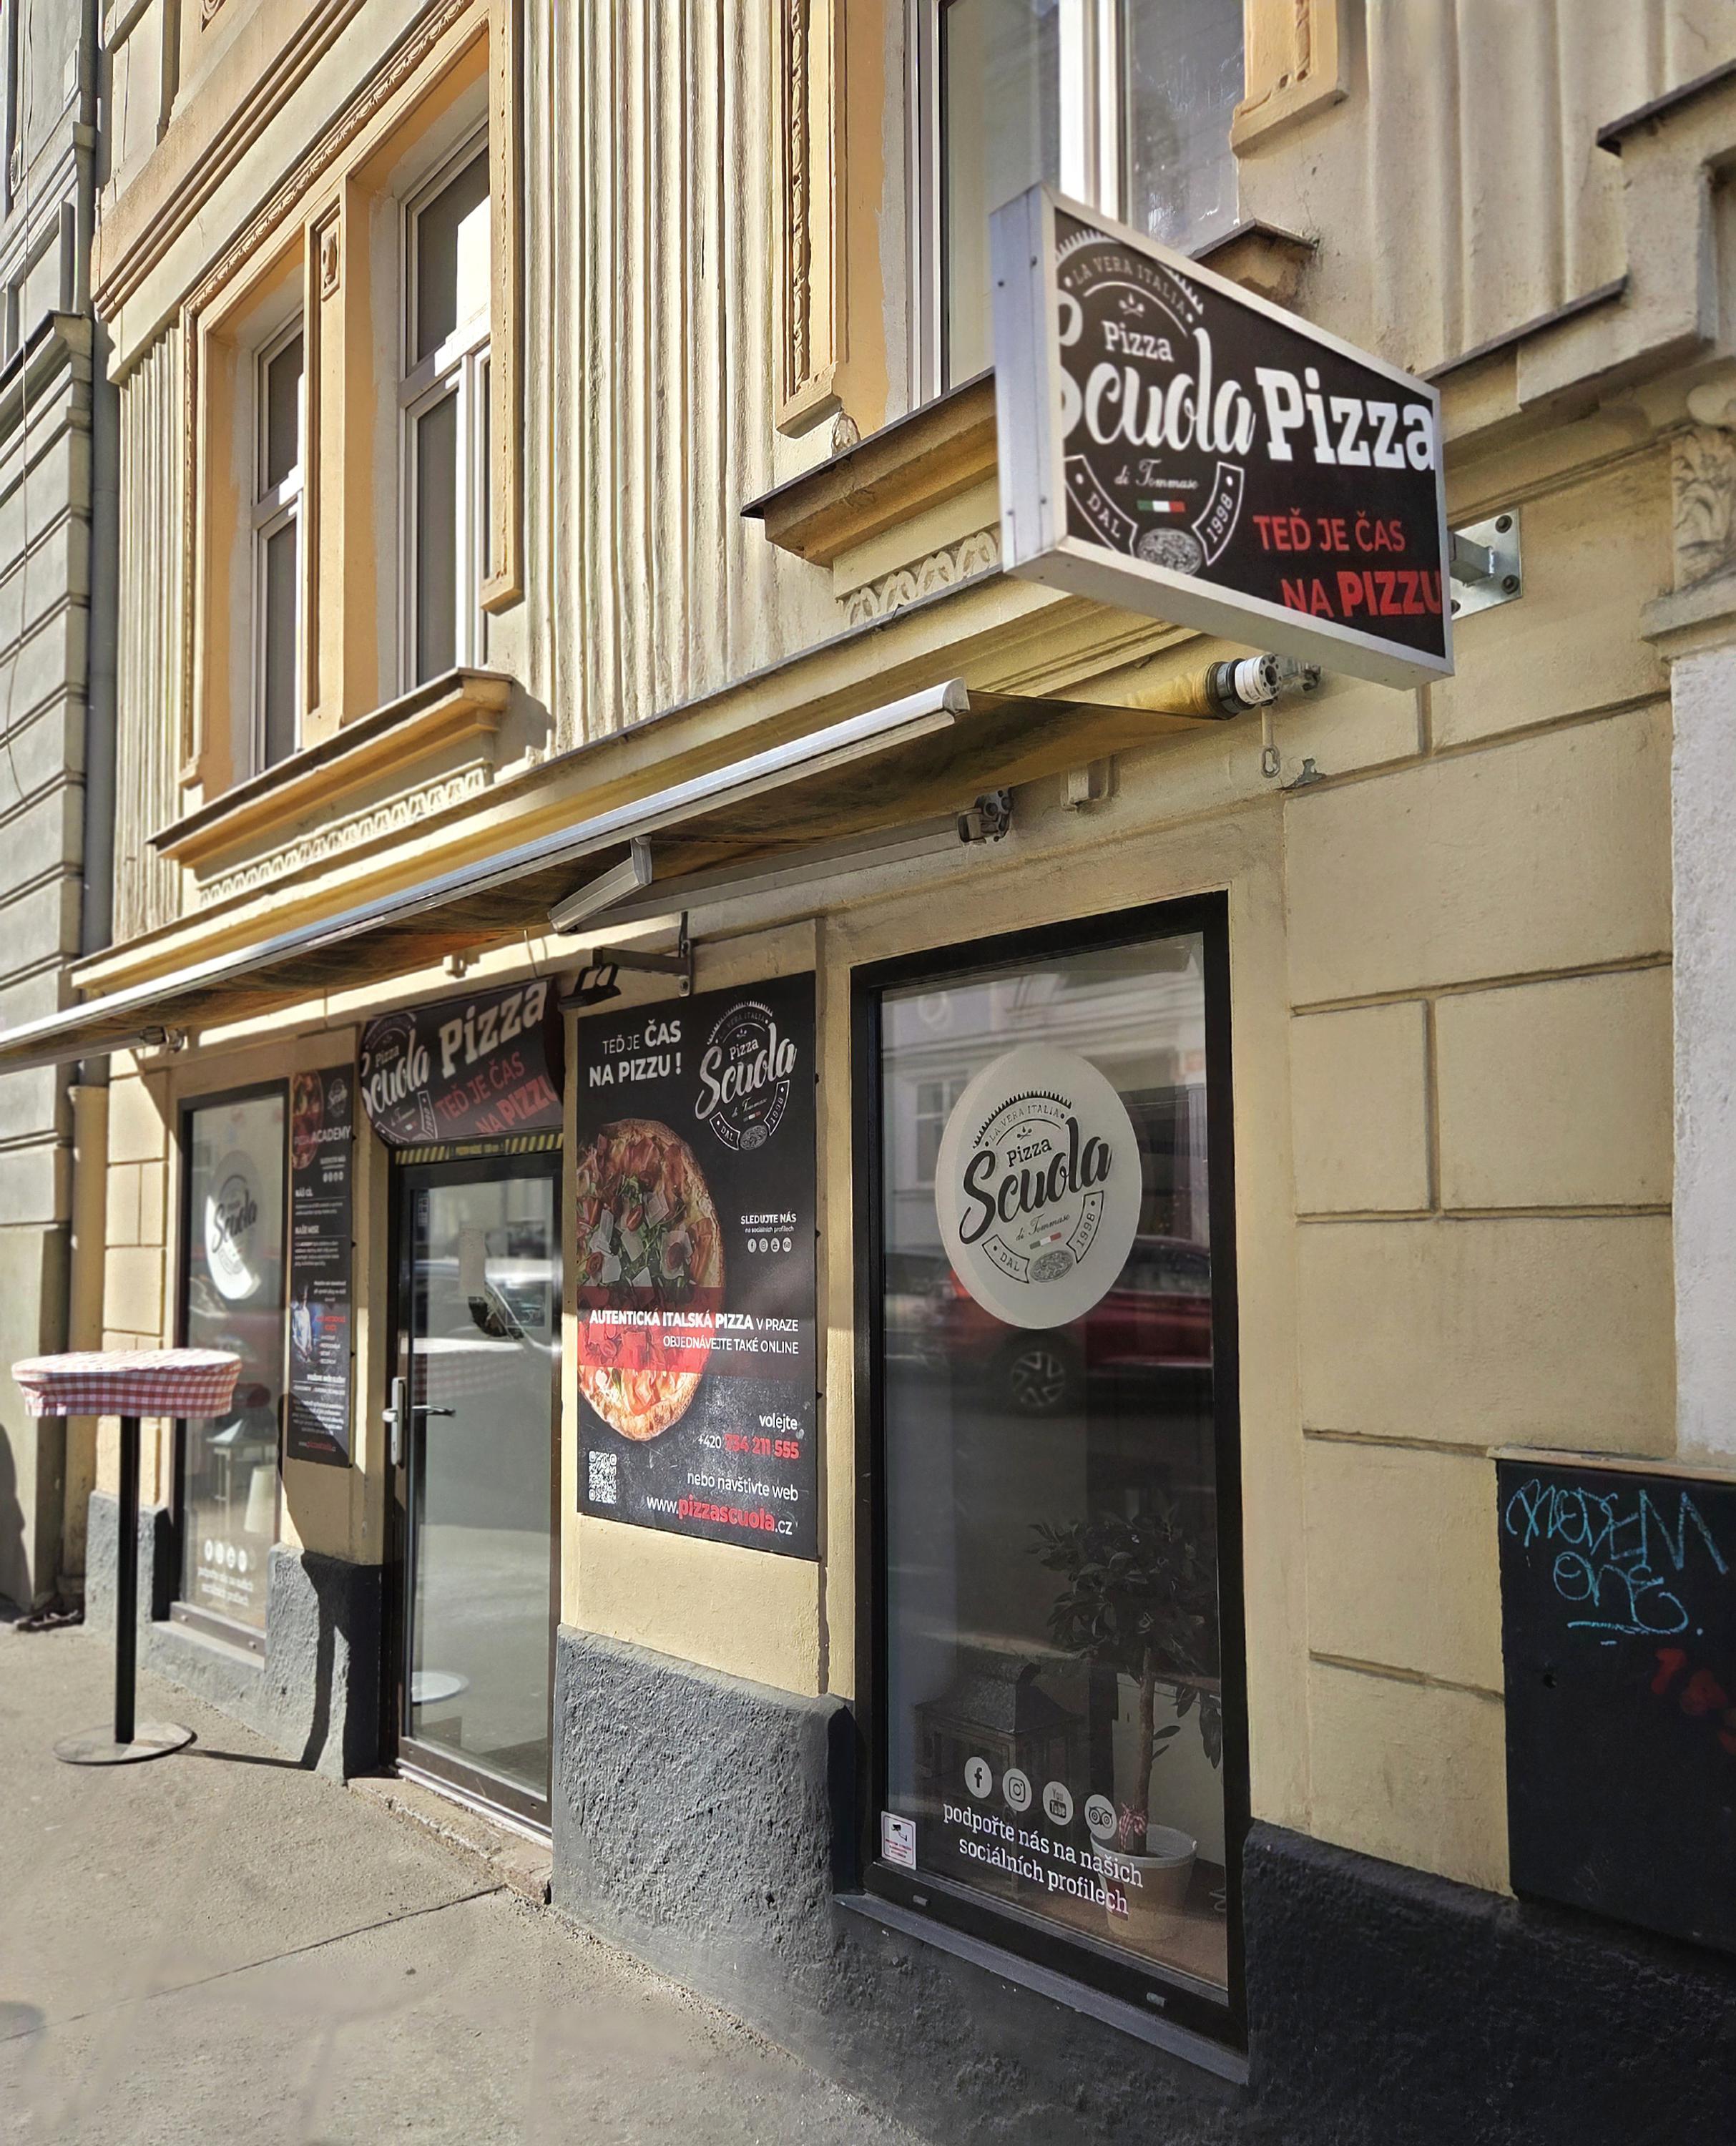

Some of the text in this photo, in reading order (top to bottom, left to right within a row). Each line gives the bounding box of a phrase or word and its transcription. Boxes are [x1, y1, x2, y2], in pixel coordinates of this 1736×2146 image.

[1073, 256, 1186, 315] LA VERA ITALIA
[1101, 320, 1175, 363] Pizza
[1255, 366, 1435, 471] Pizza
[1114, 466, 1129, 485] di
[1087, 493, 1121, 538] DAL
[1206, 493, 1233, 543] 1998
[1252, 507, 1406, 552] TEĎ JE ČAS
[1281, 571, 1442, 618] NA PIZZU
[439, 981, 547, 1079] Pizza
[602, 1019, 682, 1054] TEĎ JE ČAS
[729, 1038, 760, 1061] Pizza
[434, 1082, 469, 1120] TEĎ
[467, 1074, 491, 1104] JE
[488, 1051, 525, 1089] ČAS
[589, 1064, 614, 1087] NA
[618, 1054, 670, 1083] PIZZU
[695, 1022, 798, 1120] Scuola
[475, 1112, 507, 1135] NA
[770, 1097, 784, 1125] 1998
[989, 1104, 1059, 1142] LA VERA ITALIA
[312, 1125, 351, 1144] ACADEMY
[720, 1127, 734, 1142] DAL
[1006, 1139, 1052, 1167] Pizza
[959, 1117, 1112, 1245] Scuola
[740, 1210, 797, 1225] SLEDUJTE NÁS
[1016, 1213, 1070, 1241] di Tommaso
[1077, 1212, 1095, 1248] 1998
[1000, 1252, 1019, 1272] DAL
[589, 1308, 799, 1332] AUTENTICKÁ ITALSKÁ PIZZA V PRAZE
[663, 1334, 799, 1354] OBJEDNÁVEJTE TAKÉ ONLINE
[759, 1412, 798, 1433] volejte
[698, 1433, 800, 1459] +420 734 211 555
[687, 1471, 798, 1501] nebo navštivte web
[647, 1493, 793, 1535] www.pizzascuola.cz
[943, 1803, 1144, 1888] podpořte nás na našich
[958, 1838, 1044, 1883] sociálních
[1047, 1870, 1129, 1914] profilech
